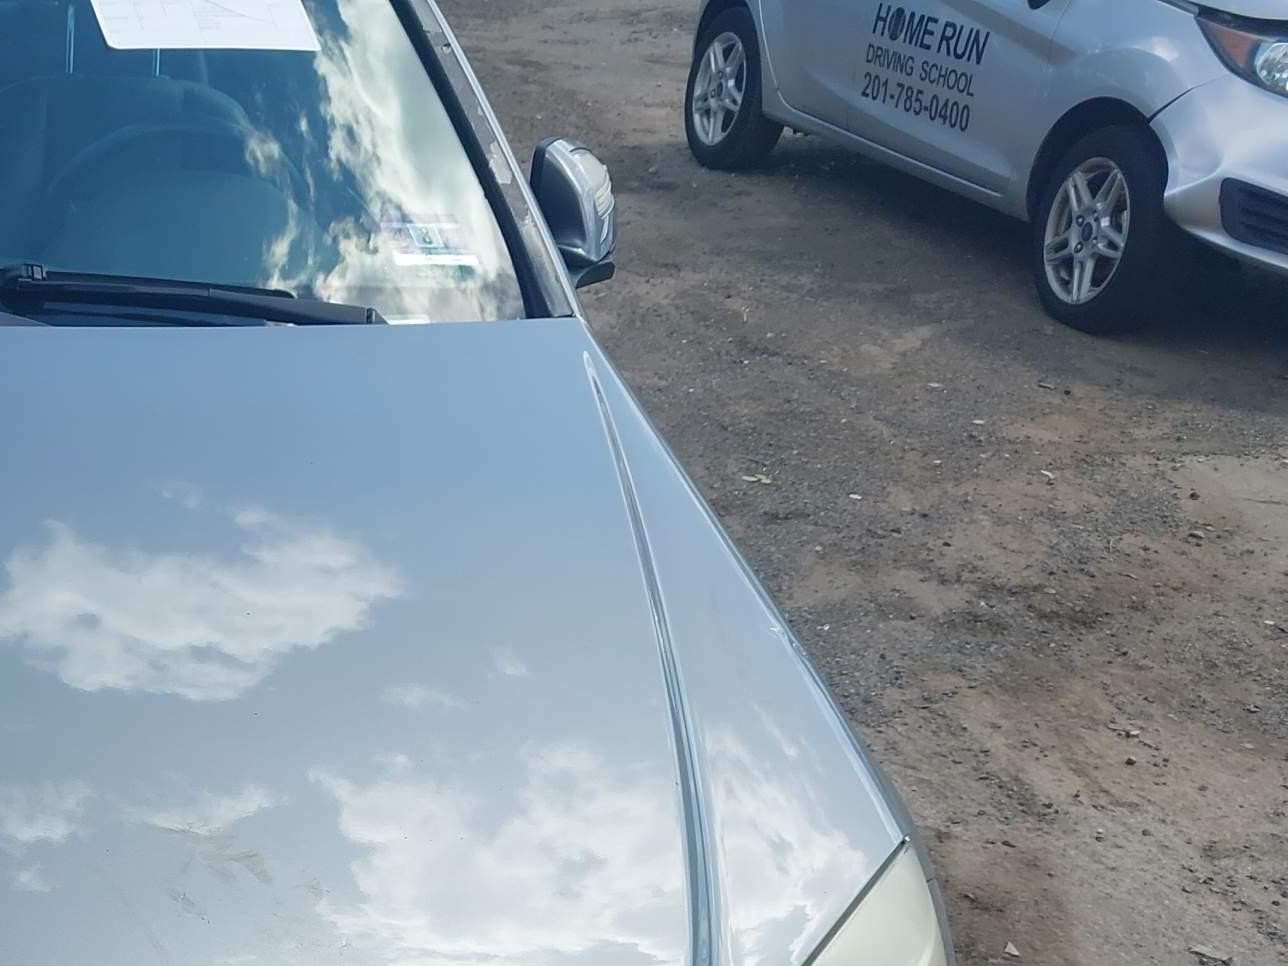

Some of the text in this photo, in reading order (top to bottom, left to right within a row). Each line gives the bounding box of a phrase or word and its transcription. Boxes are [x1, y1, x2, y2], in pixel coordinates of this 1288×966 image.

[872, 3, 990, 65] HOME RUN
[865, 43, 974, 97] DRIVING SCHOOL
[861, 71, 970, 132] 201-785-0400
